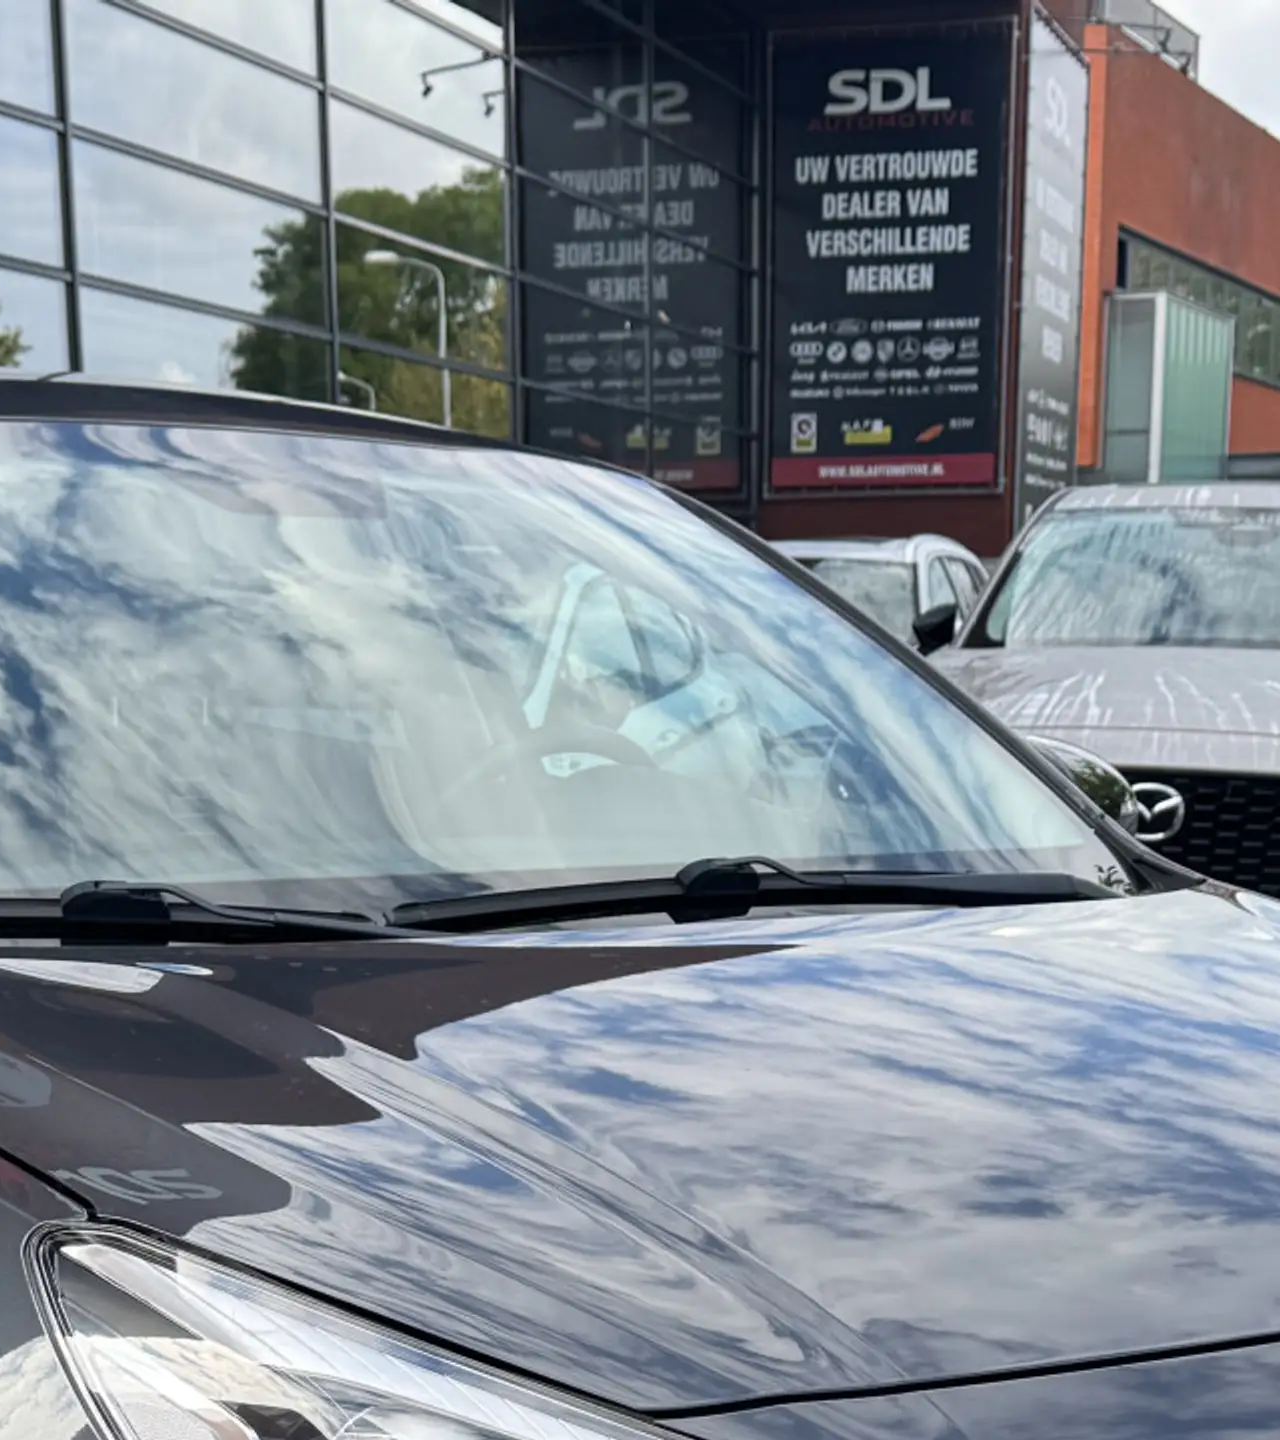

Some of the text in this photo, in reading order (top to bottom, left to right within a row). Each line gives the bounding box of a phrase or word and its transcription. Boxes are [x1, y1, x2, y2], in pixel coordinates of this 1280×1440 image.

[824, 66, 952, 115] SDL
[807, 109, 975, 132] AUTOMOTIVE
[795, 149, 979, 184] UW VERTROUWDE
[822, 187, 949, 220] DEALER VAN
[806, 224, 971, 258] VERSCHILLENDE
[846, 263, 934, 294] MERKEN
